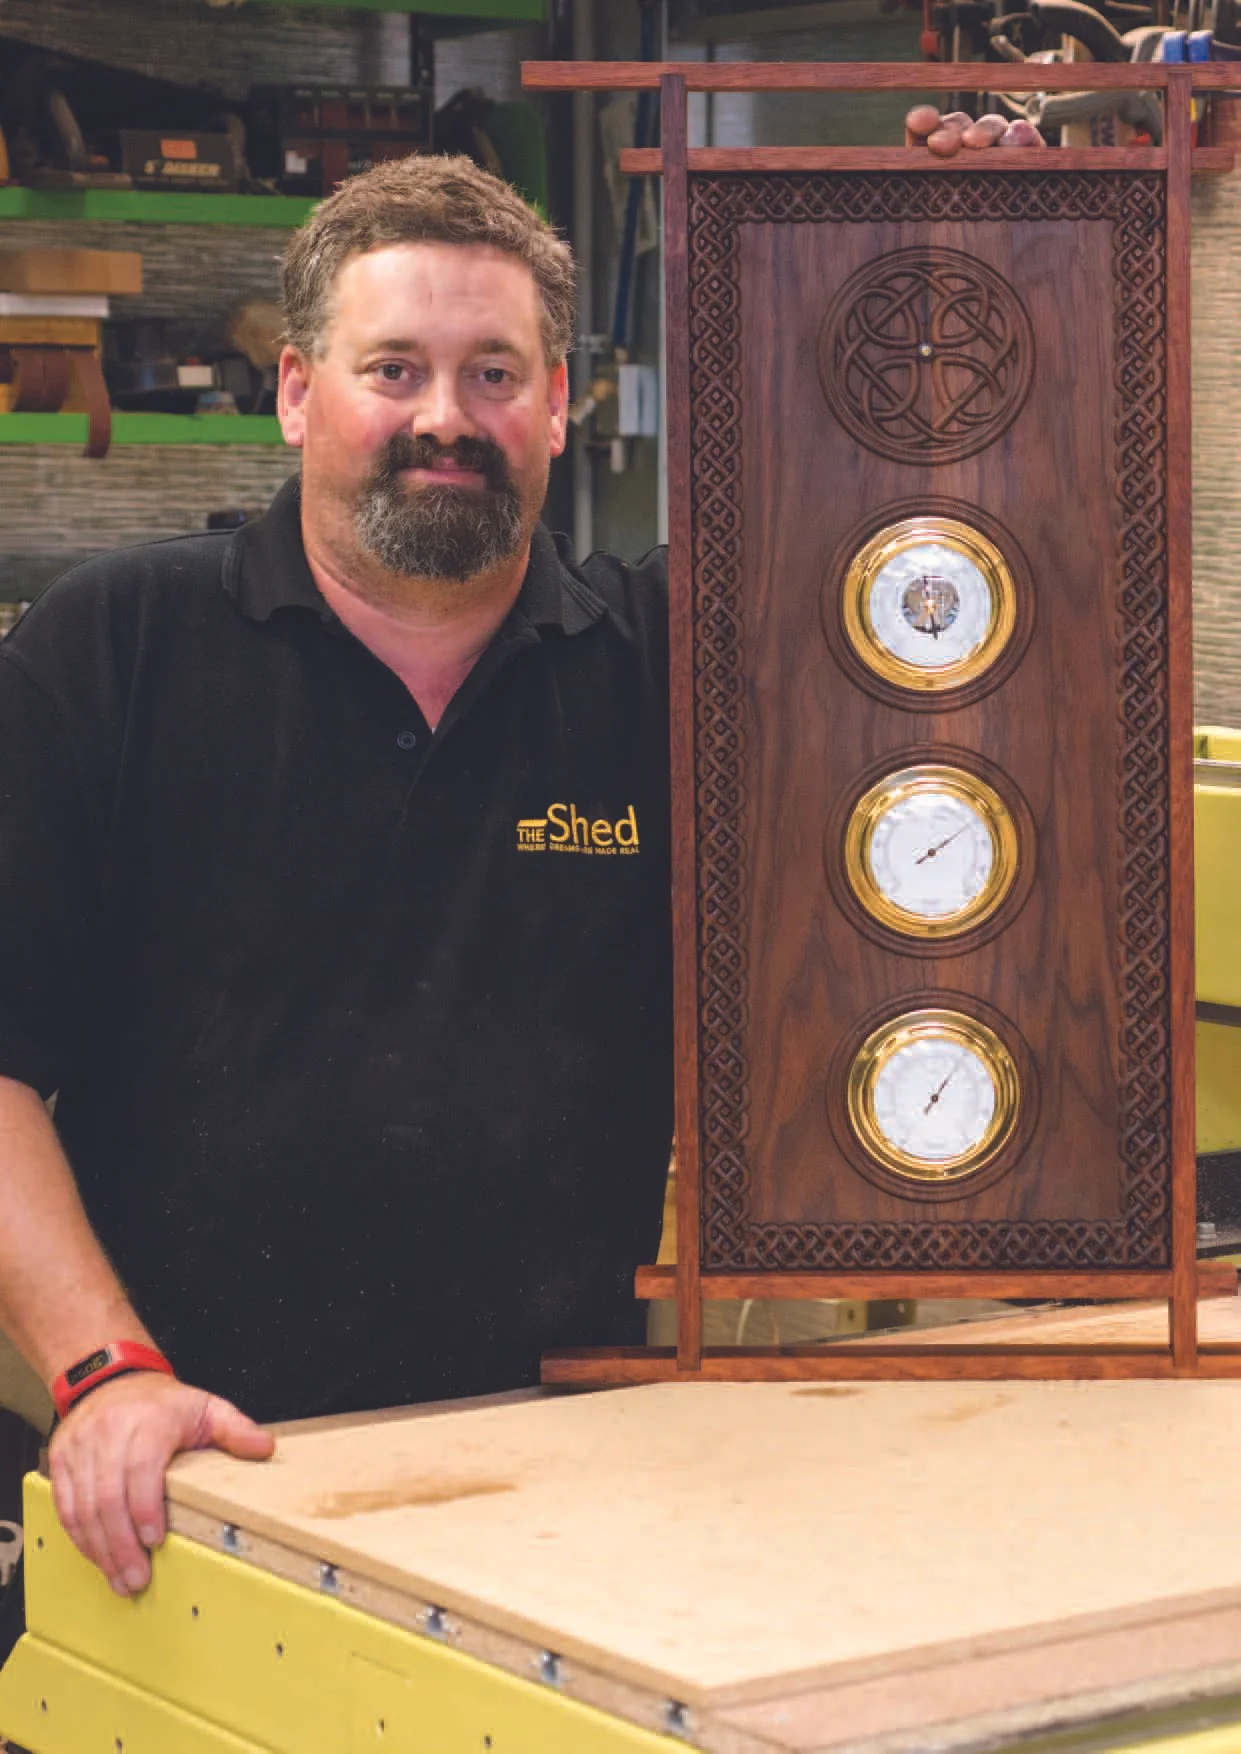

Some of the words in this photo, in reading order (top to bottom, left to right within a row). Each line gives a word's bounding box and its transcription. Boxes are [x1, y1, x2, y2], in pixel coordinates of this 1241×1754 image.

[517, 828, 545, 843] THE
[547, 803, 639, 846] Shed
[595, 846, 617, 855] MADE
[620, 846, 640, 855] REAL
